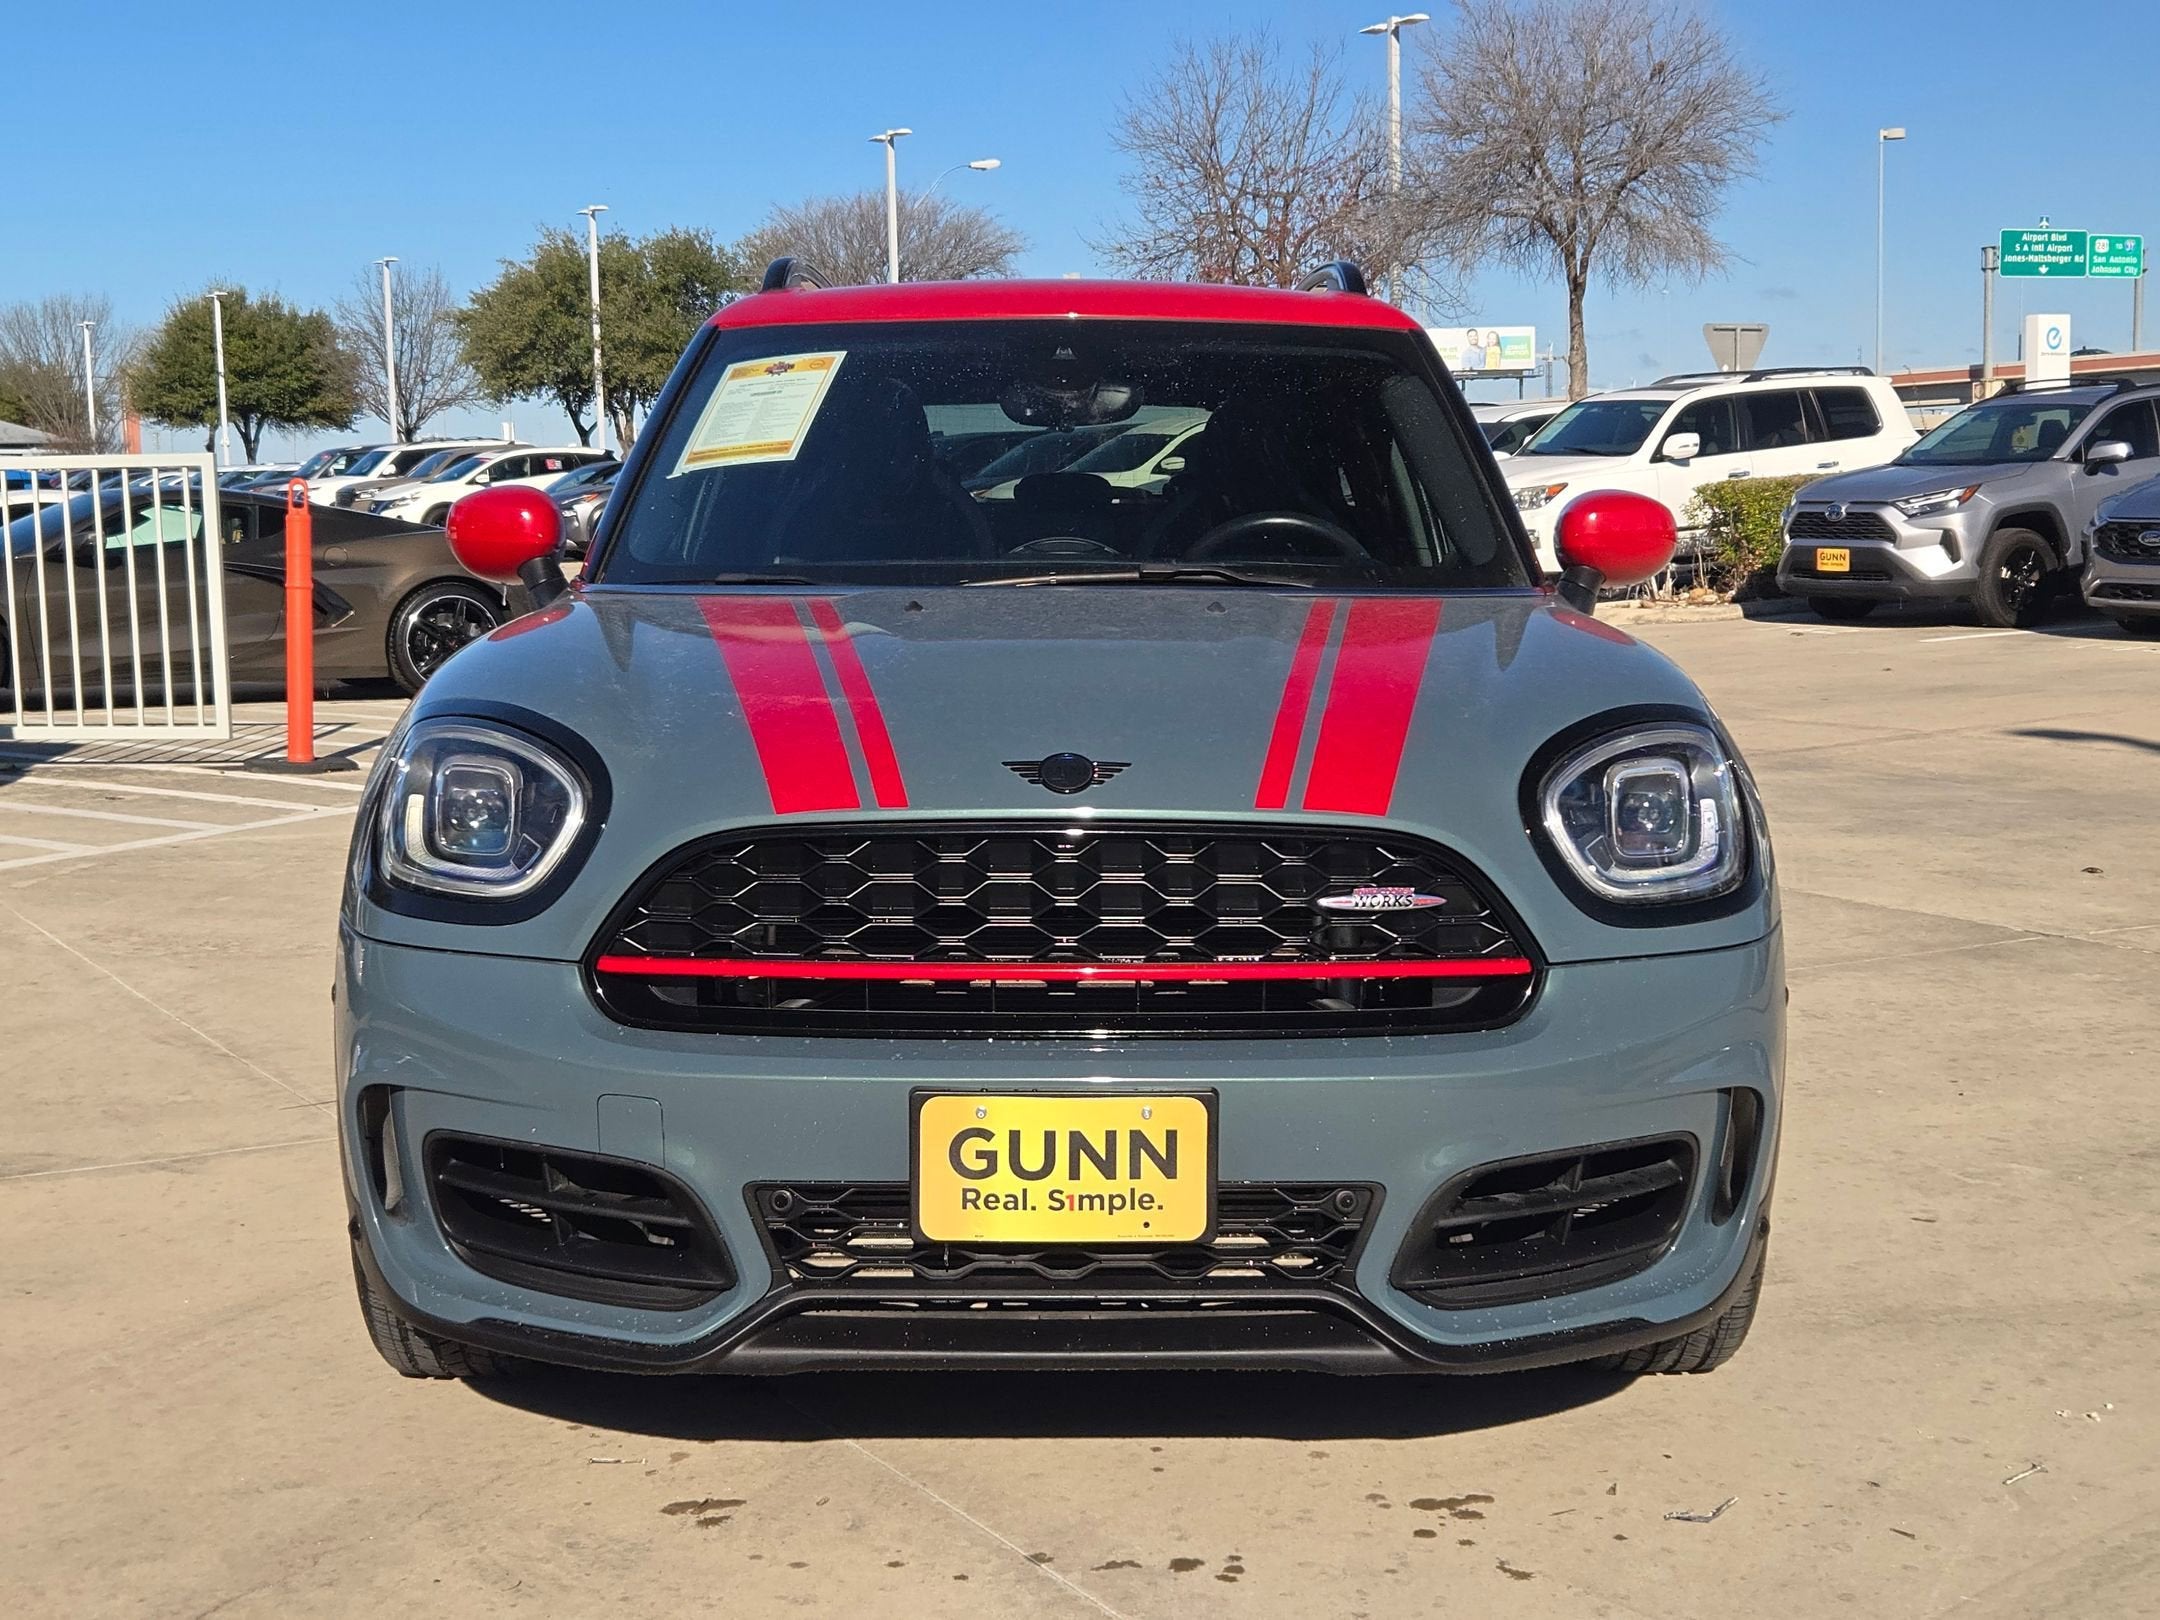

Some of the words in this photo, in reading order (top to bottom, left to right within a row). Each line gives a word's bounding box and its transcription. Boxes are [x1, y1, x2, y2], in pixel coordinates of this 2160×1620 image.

[2022, 232, 2048, 242] Airport
[2051, 233, 2067, 241] Blvd
[2047, 244, 2073, 253] Airport
[2074, 254, 2084, 262] Rd
[2092, 255, 2106, 263] San
[2109, 255, 2137, 263] Antonio
[2091, 265, 2121, 273] Johnson
[2124, 266, 2138, 275] City
[1820, 552, 1846, 561] GUNN
[1353, 894, 1414, 908] WORKS
[948, 1127, 1178, 1181] GUNN
[962, 1188, 1037, 1211] Real.
